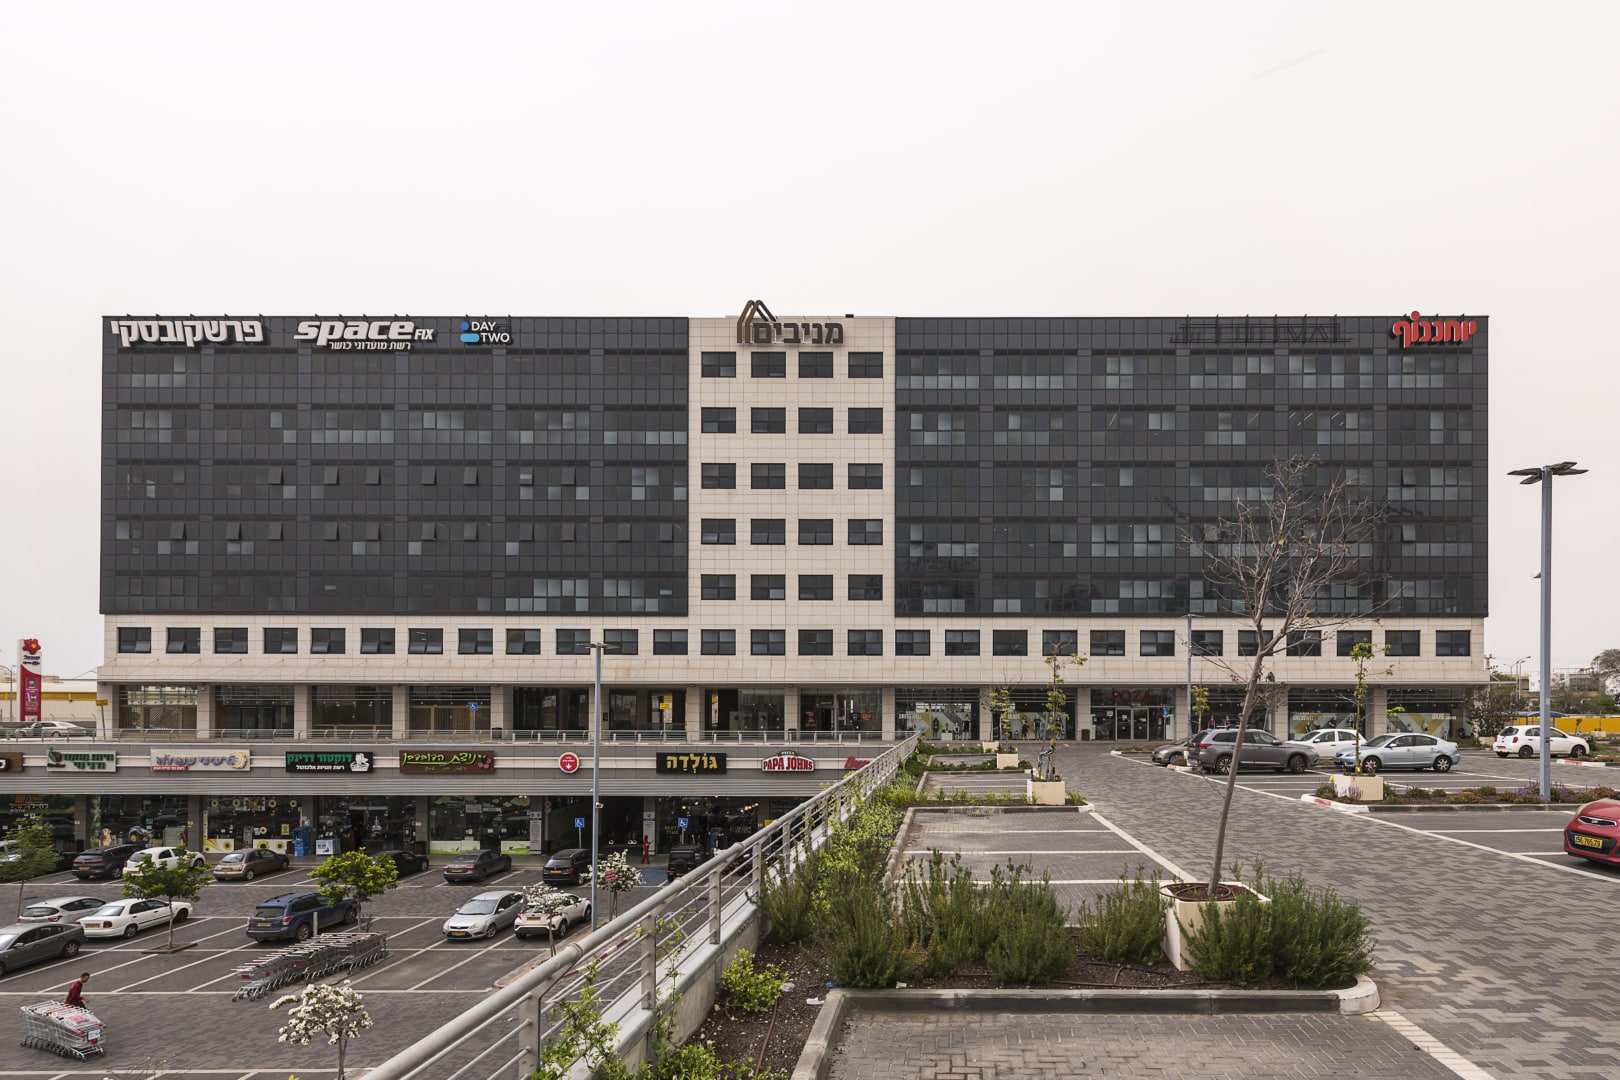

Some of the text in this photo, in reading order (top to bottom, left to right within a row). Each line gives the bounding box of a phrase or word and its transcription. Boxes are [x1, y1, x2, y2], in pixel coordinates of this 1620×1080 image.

[471, 321, 496, 331] DAY
[752, 322, 844, 344] מניבים
[1393, 311, 1476, 348] יוחננוף
[110, 320, 264, 347] פרשקובסקי
[293, 321, 434, 346] space FIX
[480, 332, 510, 343] TWO
[329, 341, 411, 350] רשת מועדוני כושר
[287, 753, 353, 765] דוקטור דרינק
[763, 756, 813, 770] PAPA JOHNS
